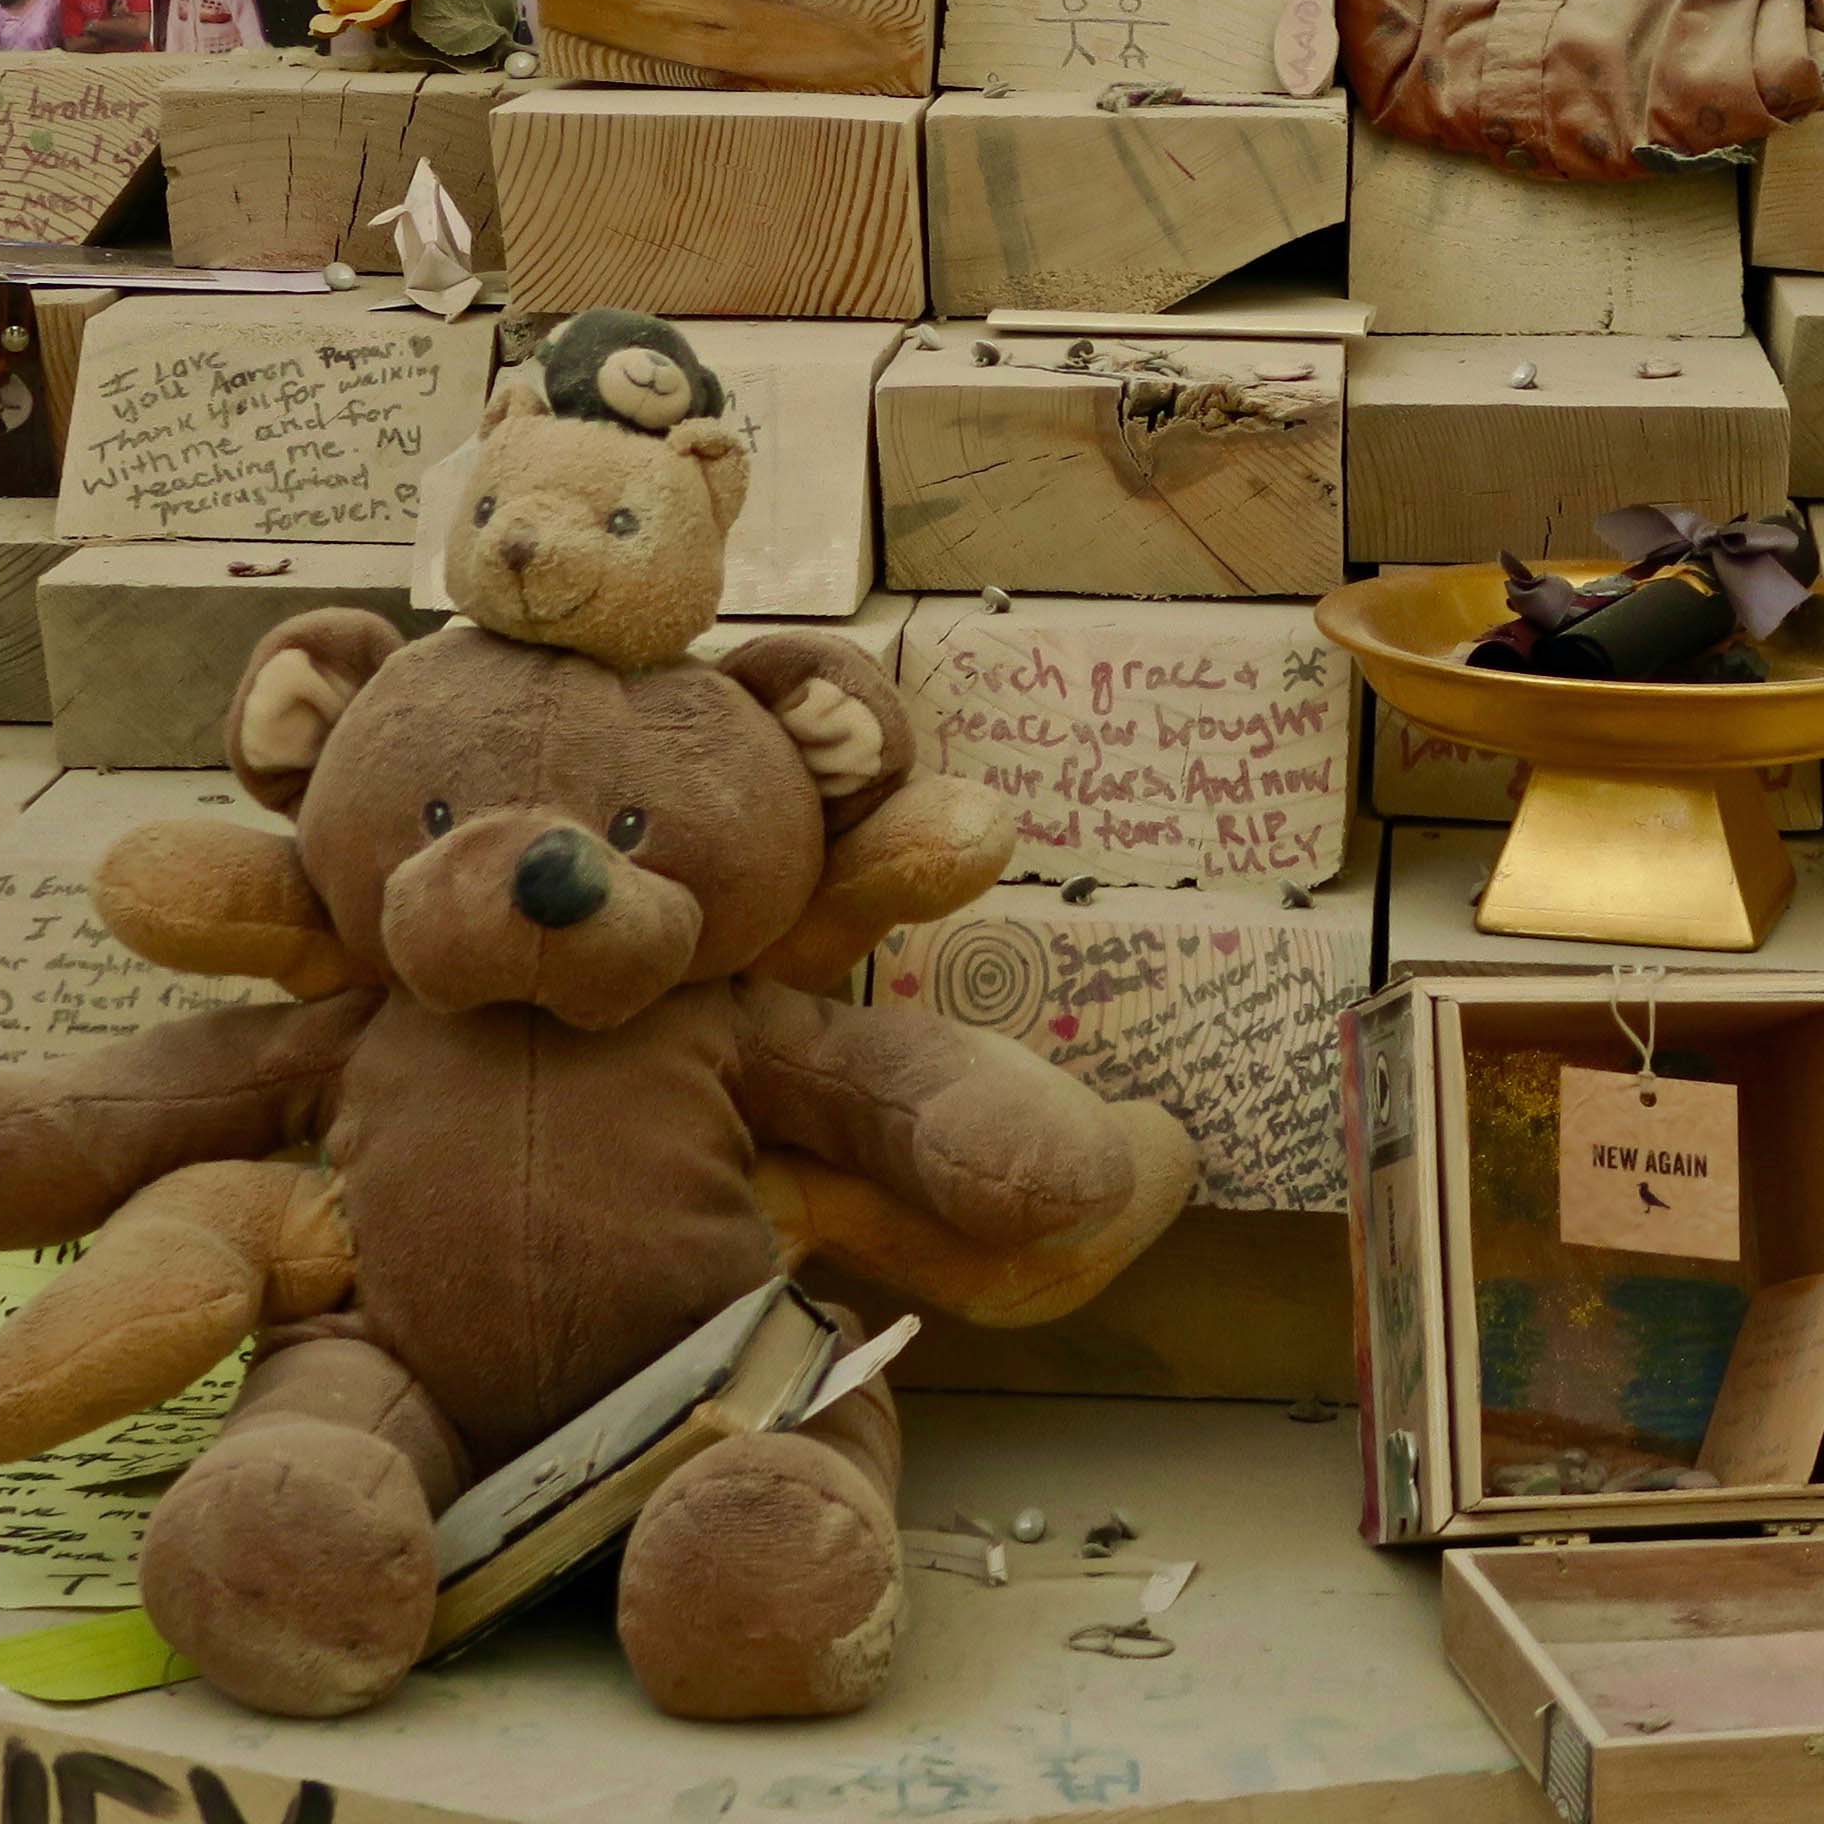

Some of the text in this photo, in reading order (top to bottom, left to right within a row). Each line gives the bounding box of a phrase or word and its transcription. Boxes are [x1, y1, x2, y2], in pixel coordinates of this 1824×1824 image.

[1215, 811, 1288, 849] RIP
[1591, 1142, 1710, 1180] NEW AGAIN
